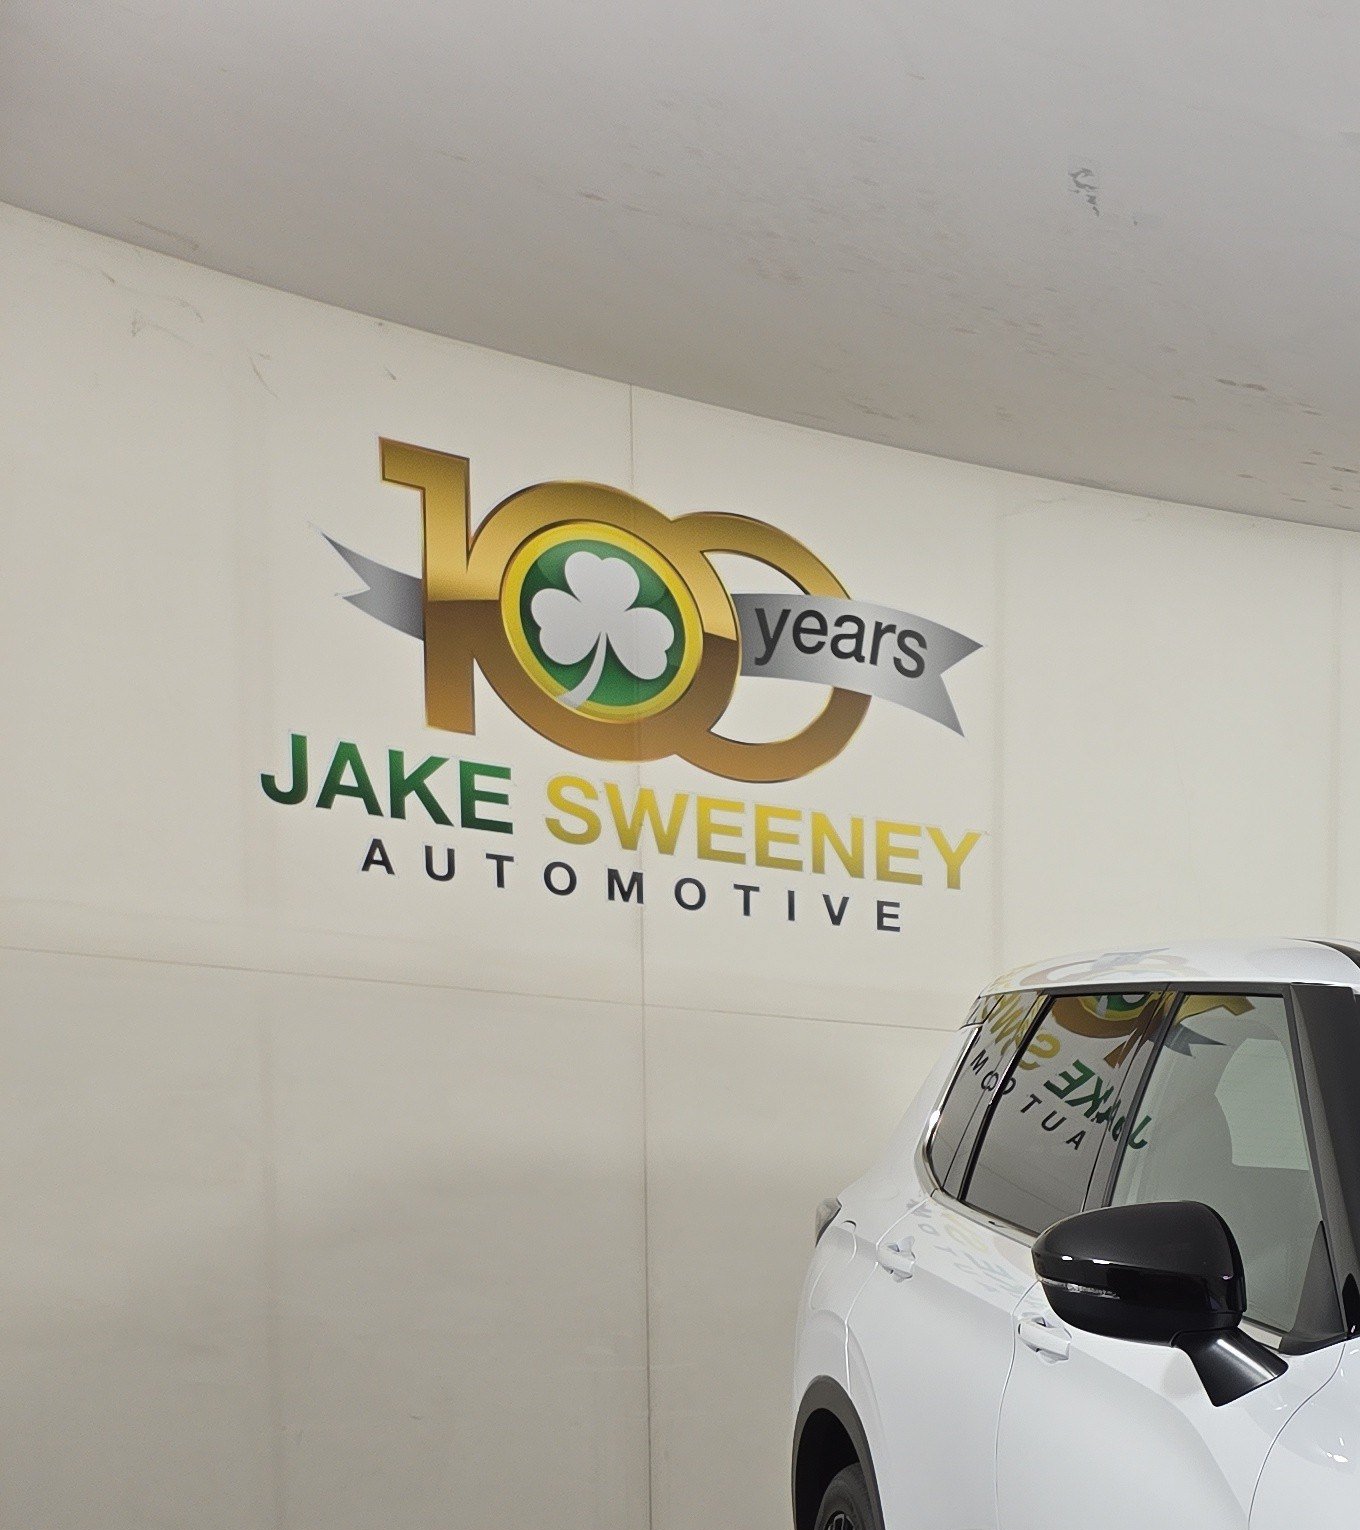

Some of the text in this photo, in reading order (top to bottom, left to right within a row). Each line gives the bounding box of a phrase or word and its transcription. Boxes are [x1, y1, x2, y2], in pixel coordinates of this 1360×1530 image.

[379, 436, 929, 784] 100 years
[260, 733, 982, 891] JAKE SWEENEY
[361, 838, 902, 933] AUTOMOTIVE
